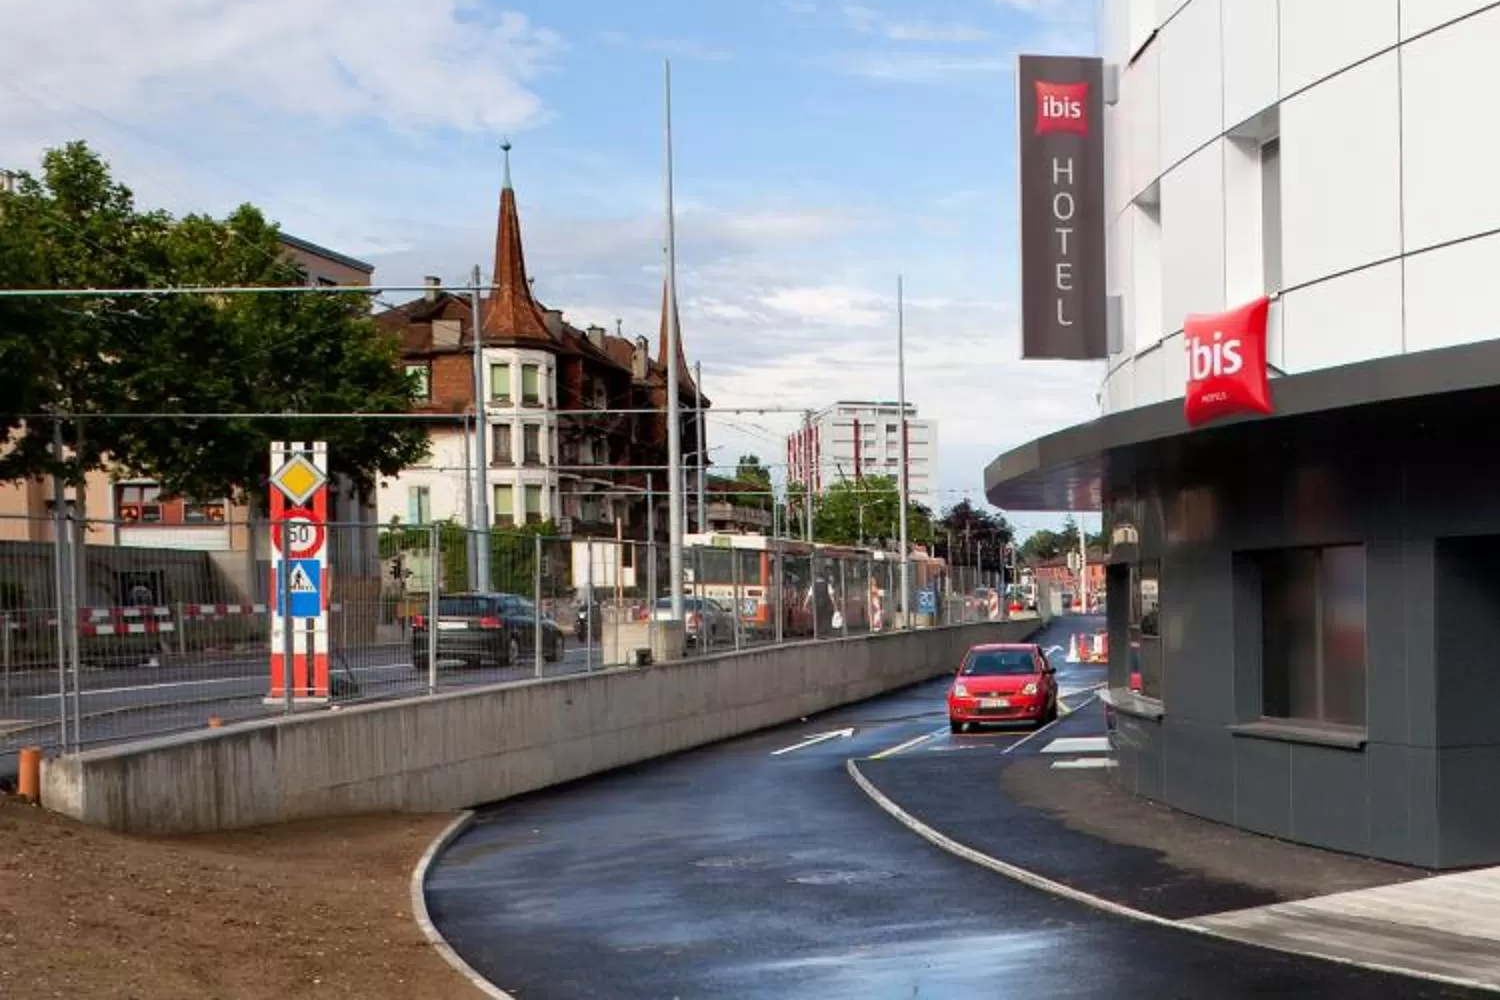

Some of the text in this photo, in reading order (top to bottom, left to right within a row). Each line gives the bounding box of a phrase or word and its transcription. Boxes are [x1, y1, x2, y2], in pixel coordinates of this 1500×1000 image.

[1042, 94, 1082, 118] ibis
[1052, 157, 1075, 327] HOTEL
[1184, 331, 1243, 381] ibis
